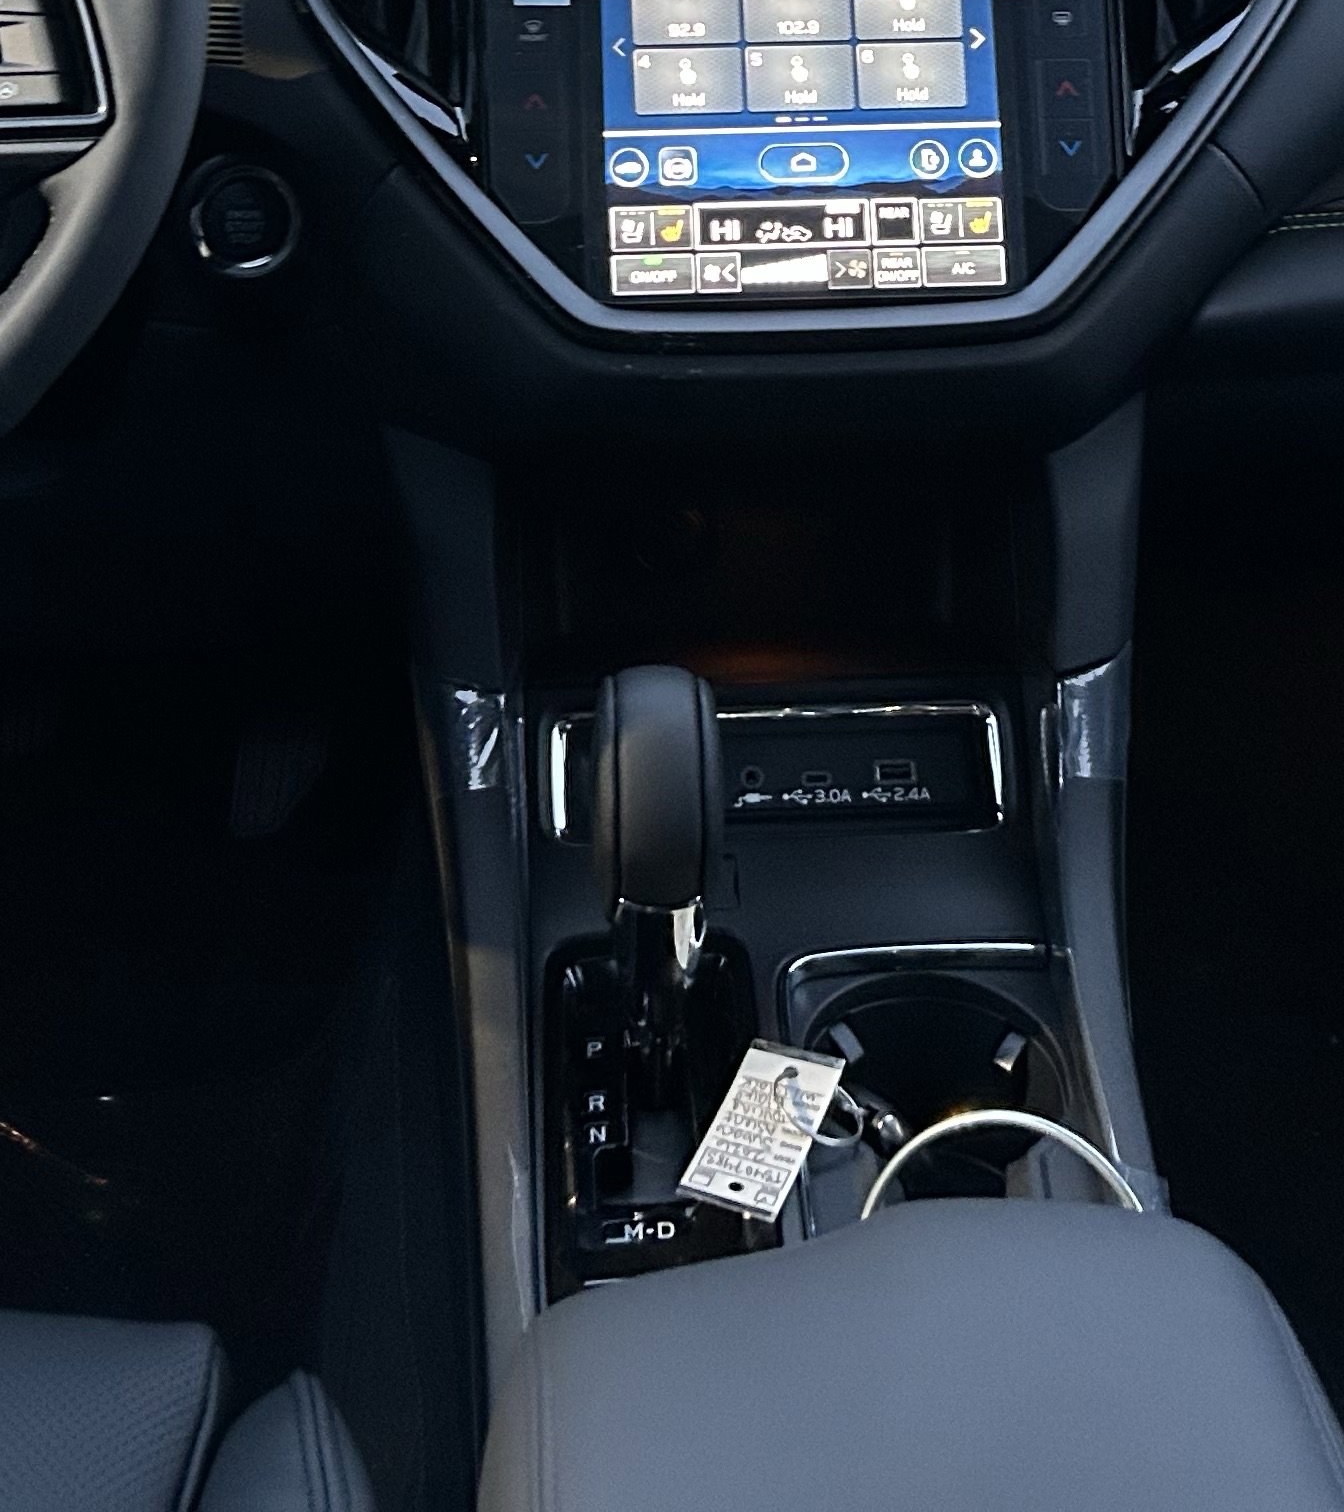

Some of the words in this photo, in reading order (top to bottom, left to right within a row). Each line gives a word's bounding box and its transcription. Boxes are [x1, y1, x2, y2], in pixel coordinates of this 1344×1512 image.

[892, 17, 926, 33] Hold
[637, 55, 651, 69] 4
[750, 52, 763, 67] 5
[861, 50, 875, 64] 6
[672, 92, 706, 108] Hold
[784, 89, 818, 105] Hold
[896, 87, 930, 103] Hold
[709, 219, 742, 242] HI
[822, 216, 855, 241] HI
[881, 256, 913, 270] REAR
[814, 788, 853, 803] 3.0A
[893, 787, 931, 802] 2.4A
[586, 1041, 602, 1059] P
[588, 1095, 605, 1112] R
[589, 1125, 606, 1144] N
